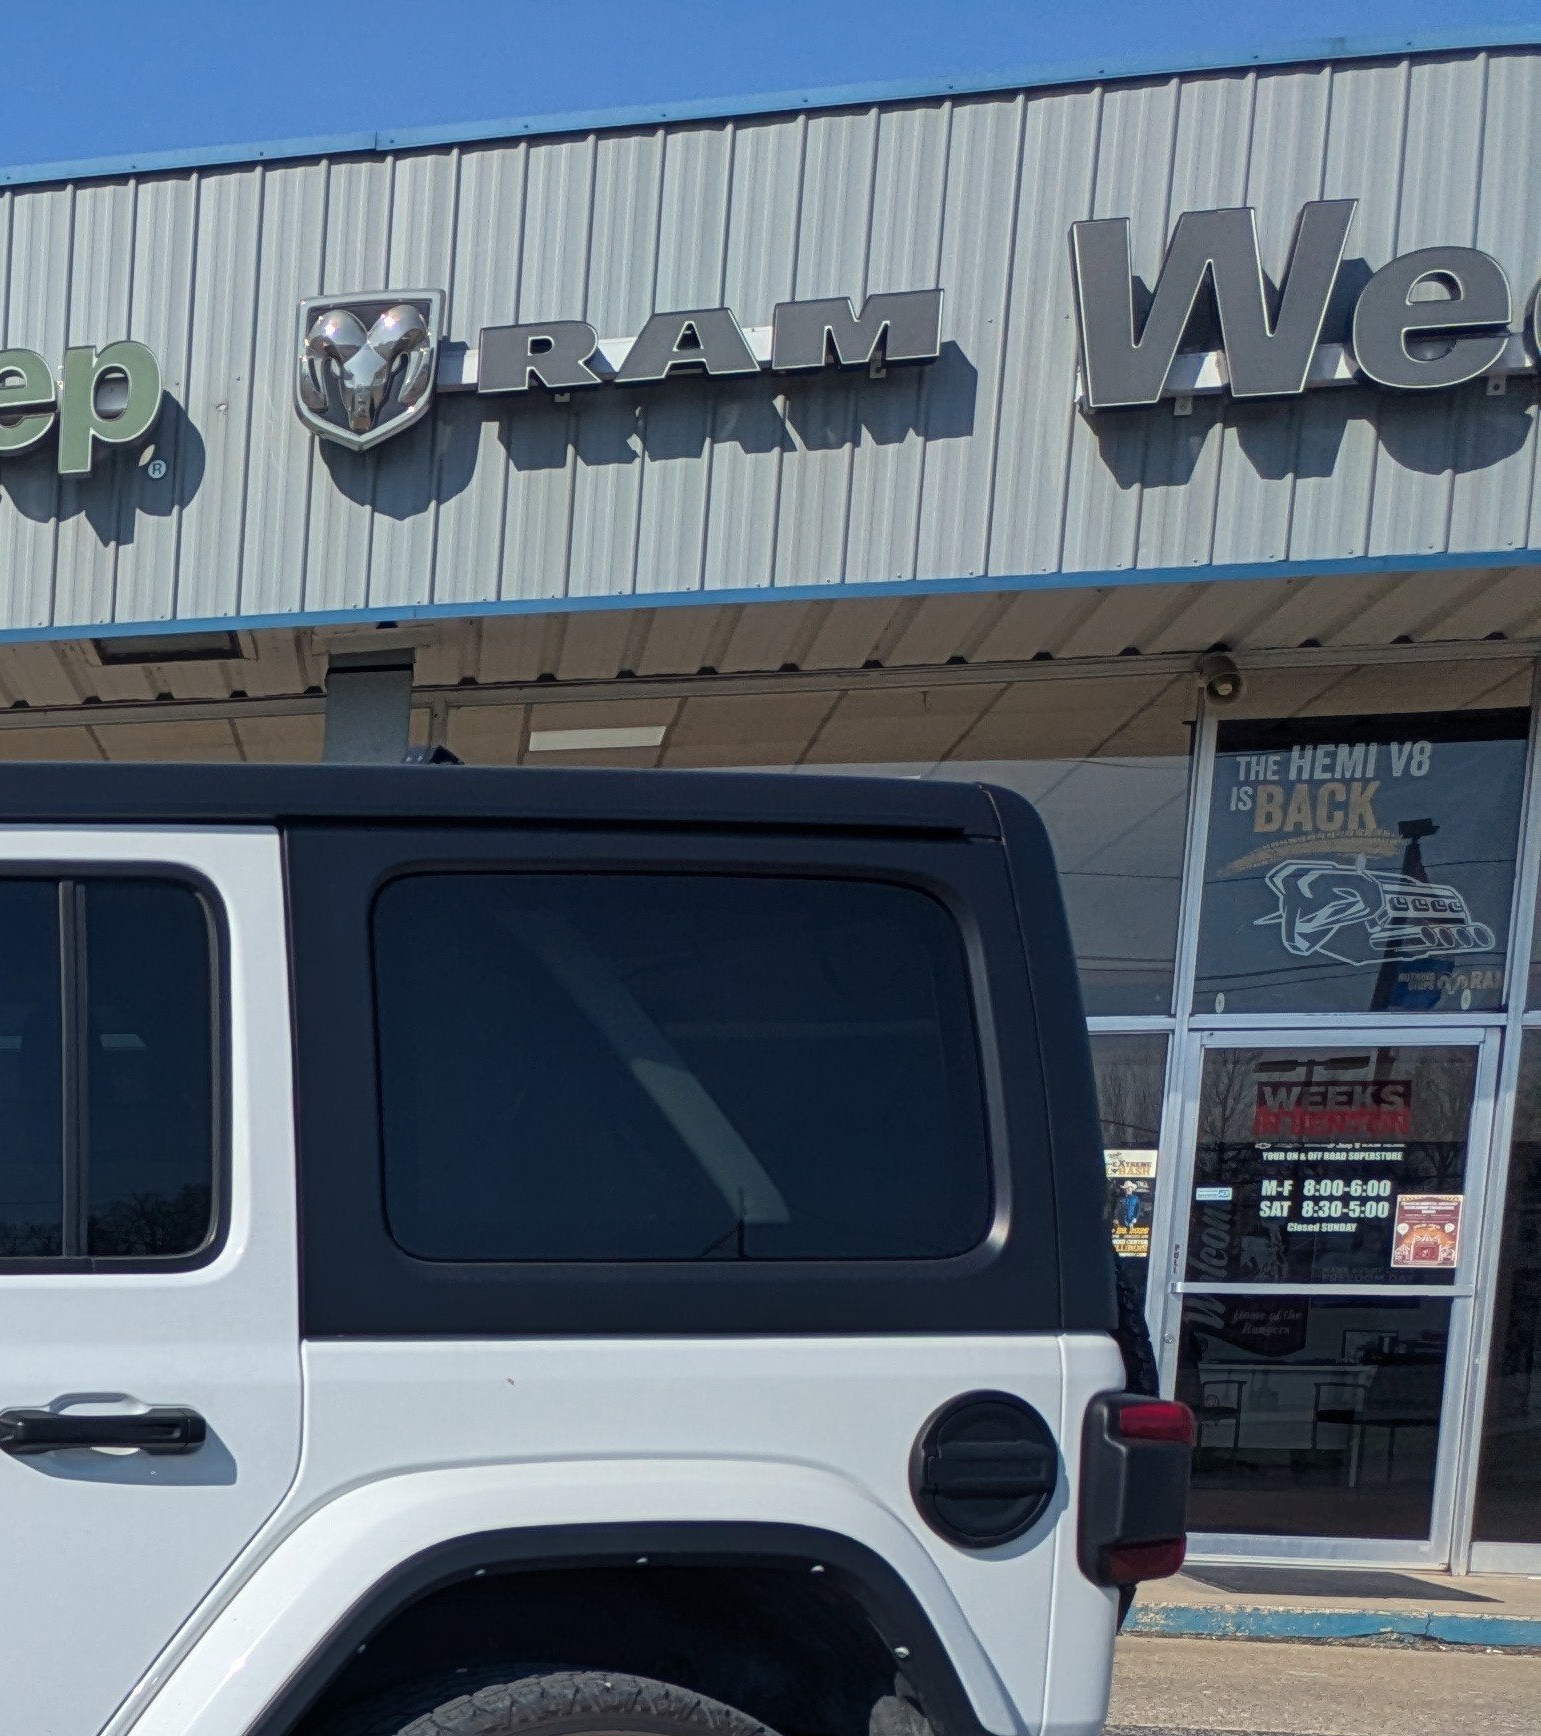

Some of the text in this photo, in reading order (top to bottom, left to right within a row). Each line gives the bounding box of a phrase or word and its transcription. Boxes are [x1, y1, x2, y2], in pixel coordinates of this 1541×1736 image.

[1068, 198, 1541, 407] We
[477, 288, 945, 393] RAM
[1235, 741, 1432, 781] THE HEMI V8
[1230, 781, 1381, 833] IS BACK
[1263, 1085, 1405, 1111] WEEKS
[1262, 1151, 1285, 1160] YOUR
[1286, 1151, 1298, 1160] ON
[1308, 1151, 1322, 1160] OFF
[1348, 1151, 1404, 1160] SUPERSTORE
[1261, 1179, 1391, 1196] M-F 8:00-6:00
[1259, 1200, 1291, 1217] SAT
[1301, 1200, 1389, 1218] 8:30-5:00
[1287, 1222, 1357, 1232] Closed SUNDAY
